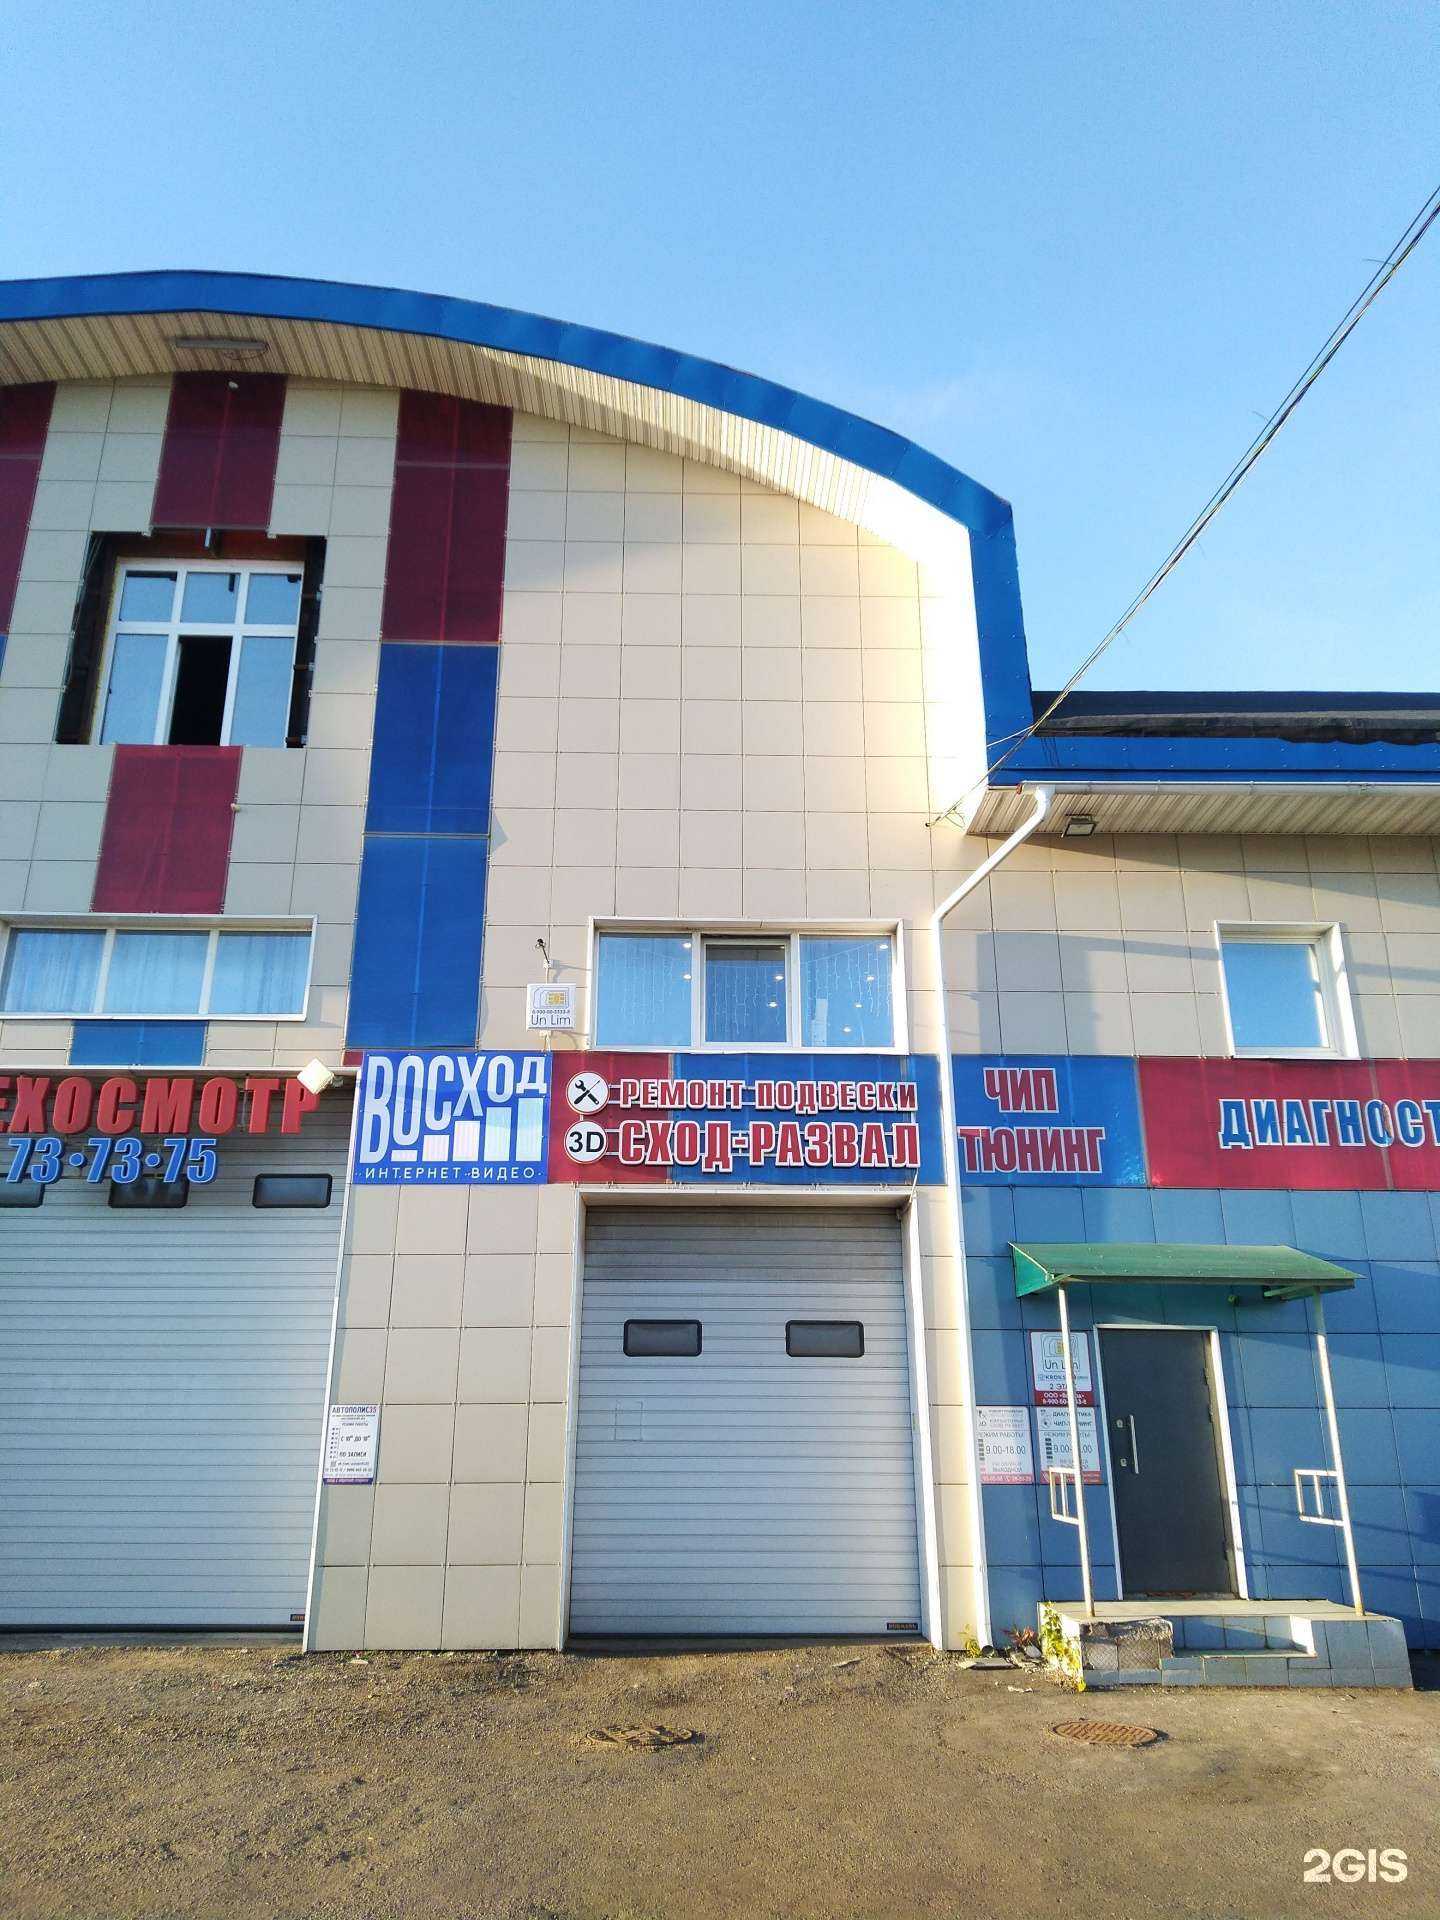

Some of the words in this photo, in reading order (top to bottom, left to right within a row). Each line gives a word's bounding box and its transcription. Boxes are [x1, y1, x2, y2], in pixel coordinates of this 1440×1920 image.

[531, 1014, 547, 1025] Un
[551, 1014, 571, 1025] Lim
[360, 1055, 547, 1164] ВОСХОД
[619, 1079, 746, 1109] РЕМОНТ
[754, 1081, 918, 1115] ПОДВЕСКИ
[983, 1067, 1059, 1114] ЧИП
[568, 1130, 605, 1153] 3D
[618, 1119, 921, 1173] СХОД-РАЗВАЛ
[957, 1126, 1106, 1174] ТЮНИНГ
[365, 1167, 462, 1179] ИНТЕРНЕТ
[470, 1167, 535, 1181] ВИДЕО
